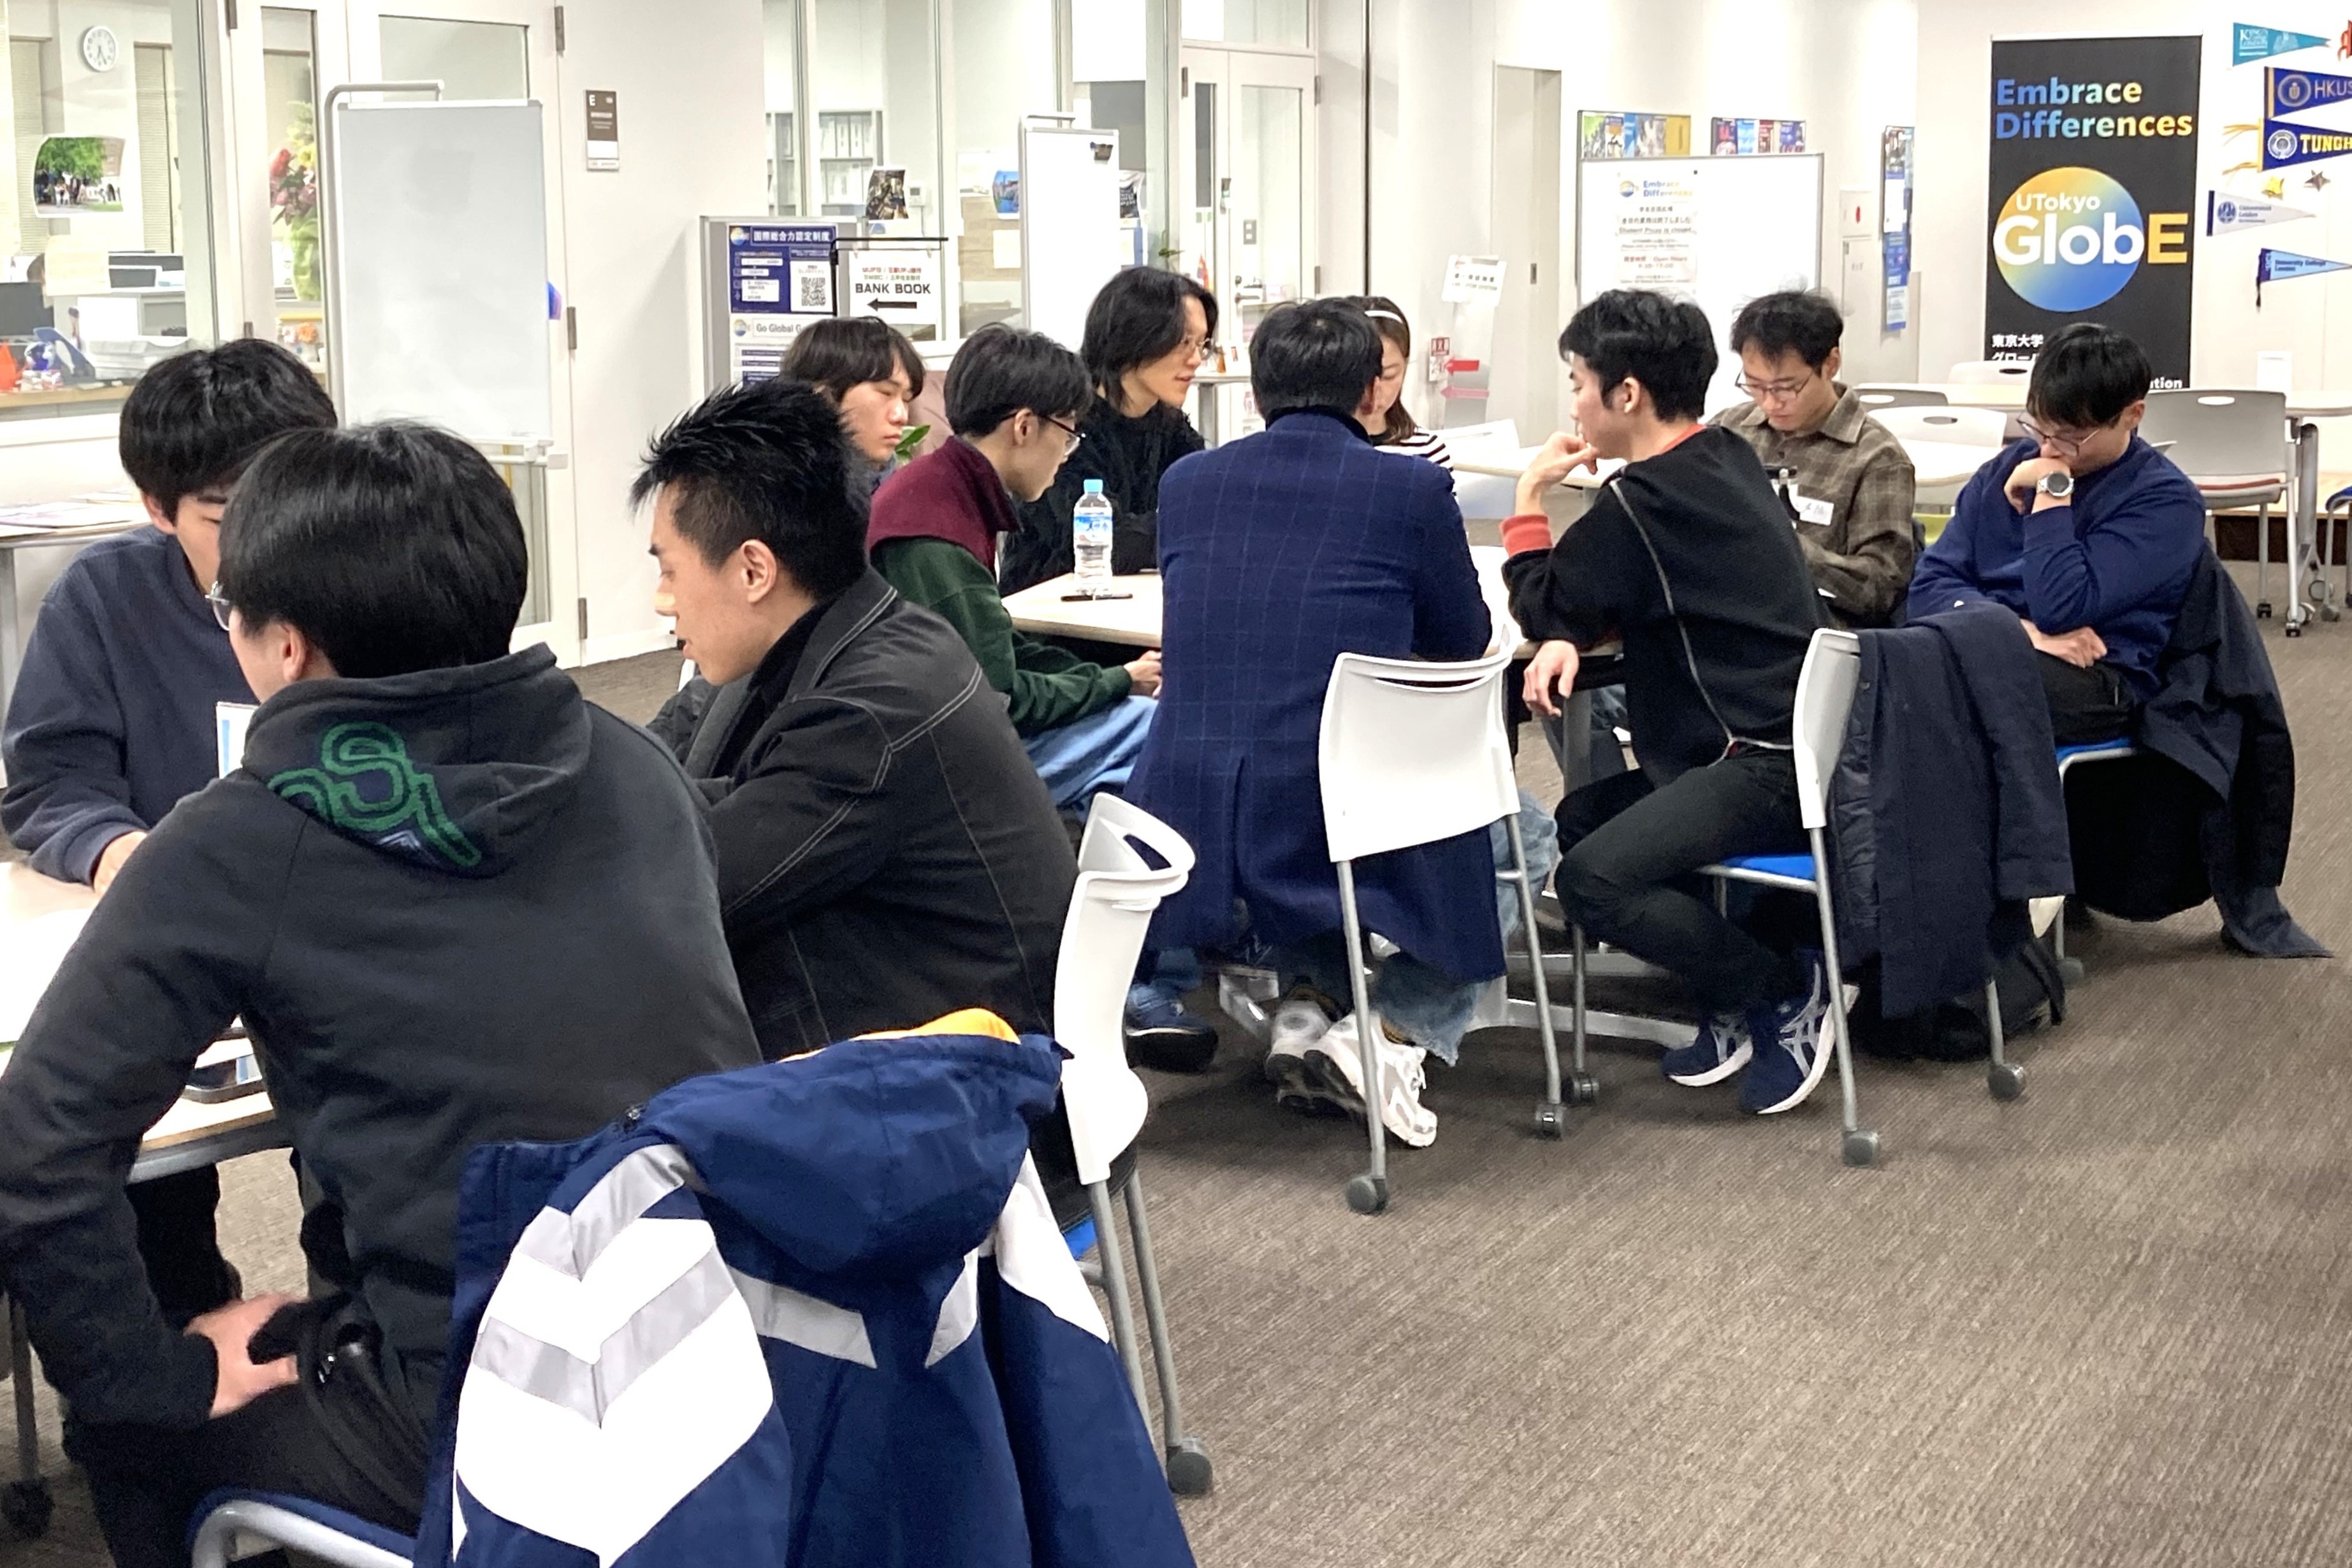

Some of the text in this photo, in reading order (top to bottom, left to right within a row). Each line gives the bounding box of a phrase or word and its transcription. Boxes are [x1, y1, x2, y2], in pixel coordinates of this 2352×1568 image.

[1996, 76, 2142, 105] Embrace
[589, 94, 596, 106] E
[1996, 110, 2193, 139] Differences
[2300, 133, 2352, 154] TUNGH
[2016, 193, 2100, 214] UTokyo
[753, 231, 831, 242] 国際総合力認定制度
[1993, 212, 2188, 265] GlobE
[855, 283, 931, 294] BANK BOOK
[757, 323, 767, 332] Go
[769, 323, 794, 333] Global
[1992, 333, 2043, 348] 東京大学
